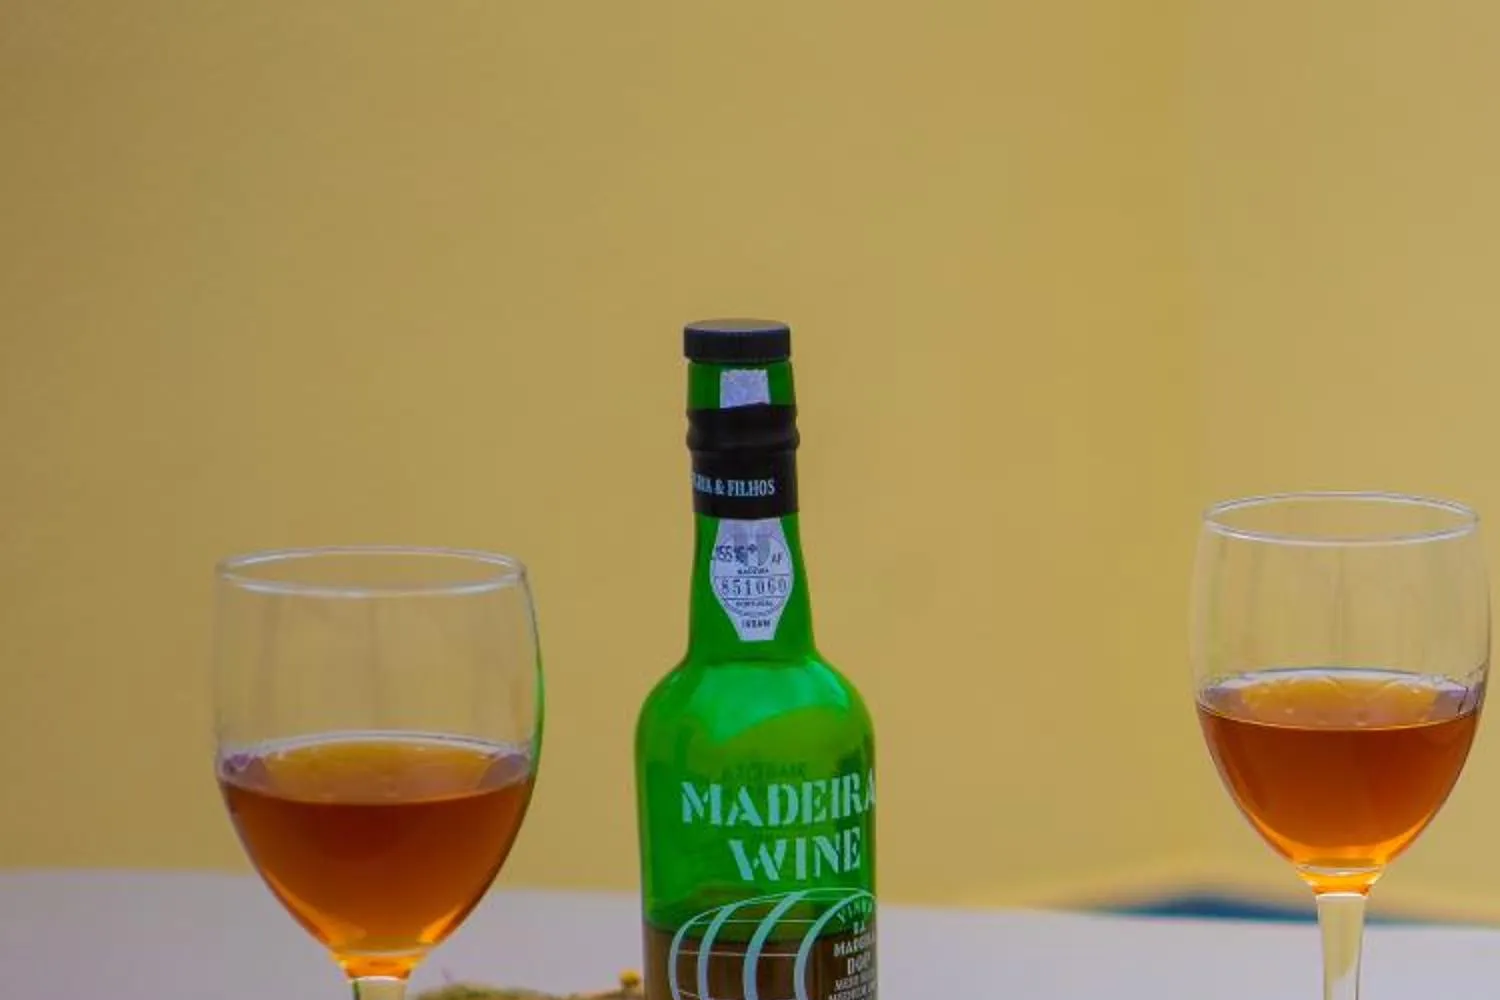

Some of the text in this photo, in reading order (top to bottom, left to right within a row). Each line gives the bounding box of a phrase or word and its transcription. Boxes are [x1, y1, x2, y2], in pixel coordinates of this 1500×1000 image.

[713, 479, 725, 495] &
[727, 478, 776, 497] FILHOS
[681, 768, 877, 826] MADEIRA
[728, 826, 861, 881] WINE
